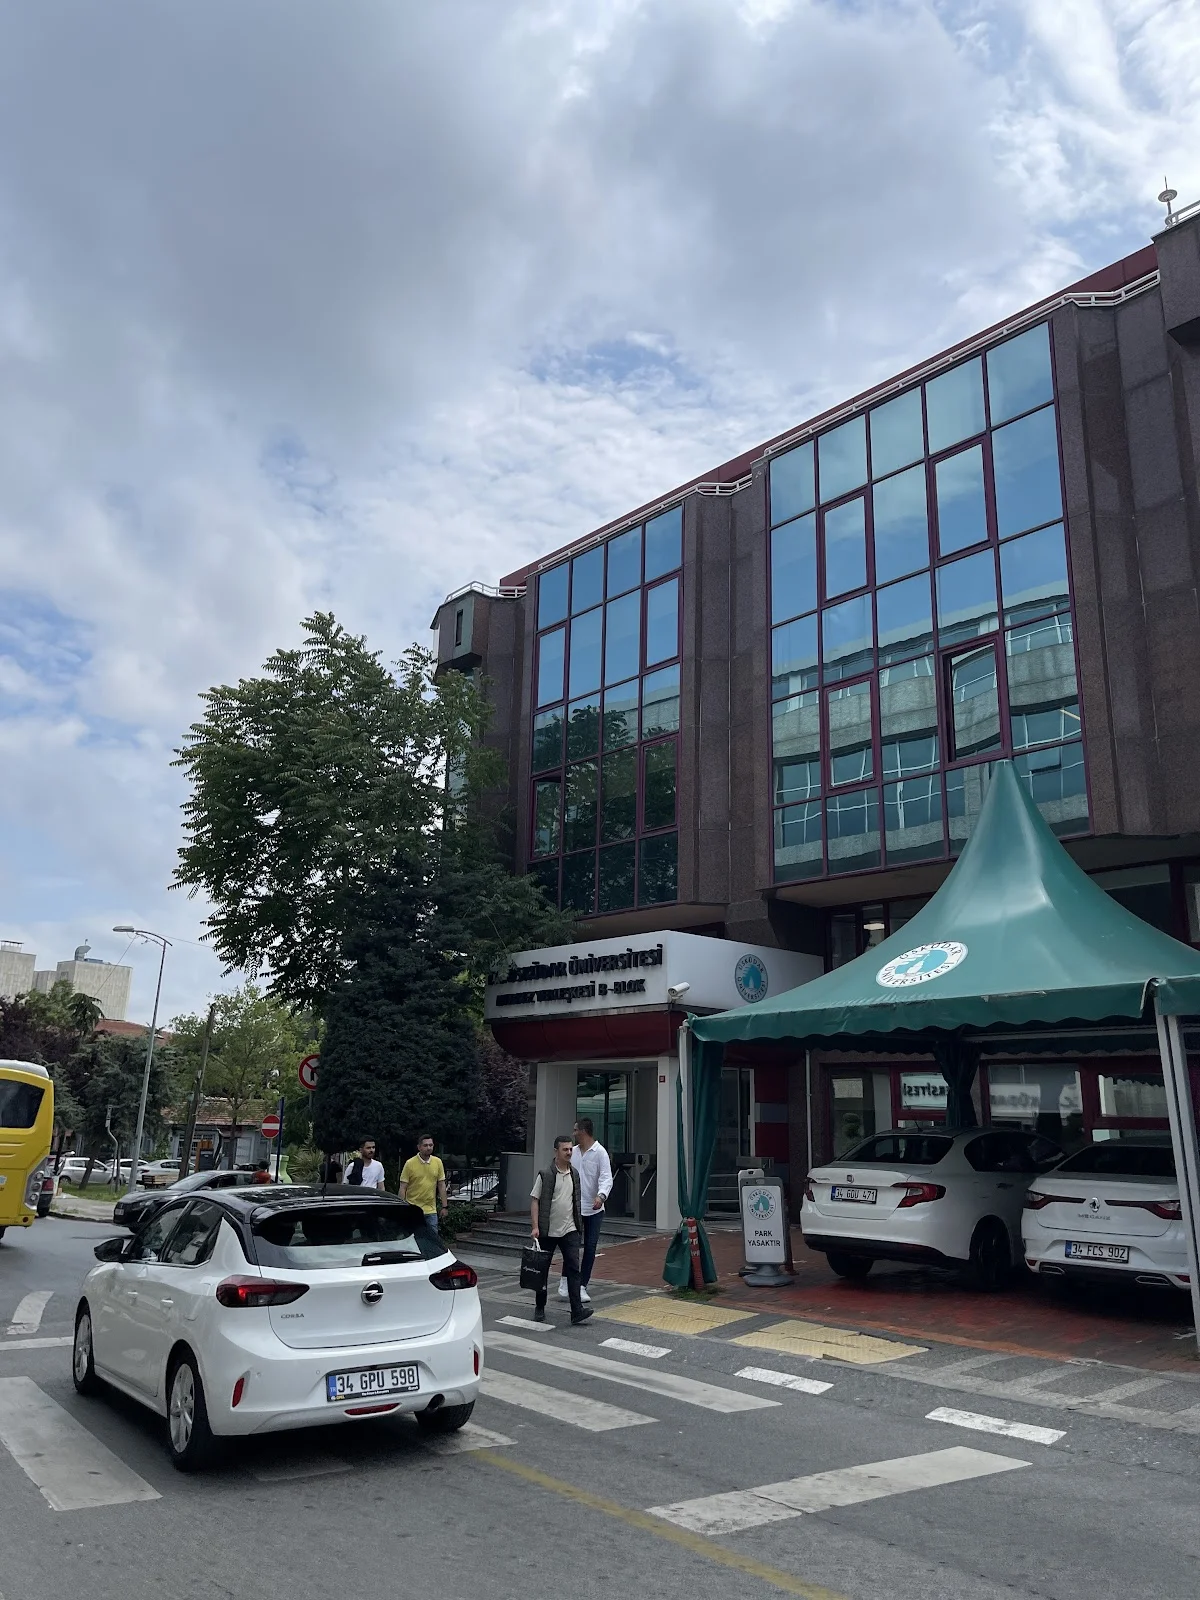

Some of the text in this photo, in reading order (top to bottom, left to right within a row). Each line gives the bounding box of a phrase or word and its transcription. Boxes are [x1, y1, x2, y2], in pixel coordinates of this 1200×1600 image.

[568, 943, 663, 976] ÜNİVERSİTESİ
[836, 1188, 843, 1198] 34
[862, 1190, 875, 1202] 471
[748, 1239, 781, 1247] YASAKTIR
[1072, 1243, 1125, 1258] 34 FCS 902
[337, 1375, 354, 1393] 34
[360, 1371, 385, 1391] GPU
[391, 1367, 415, 1386] 598
